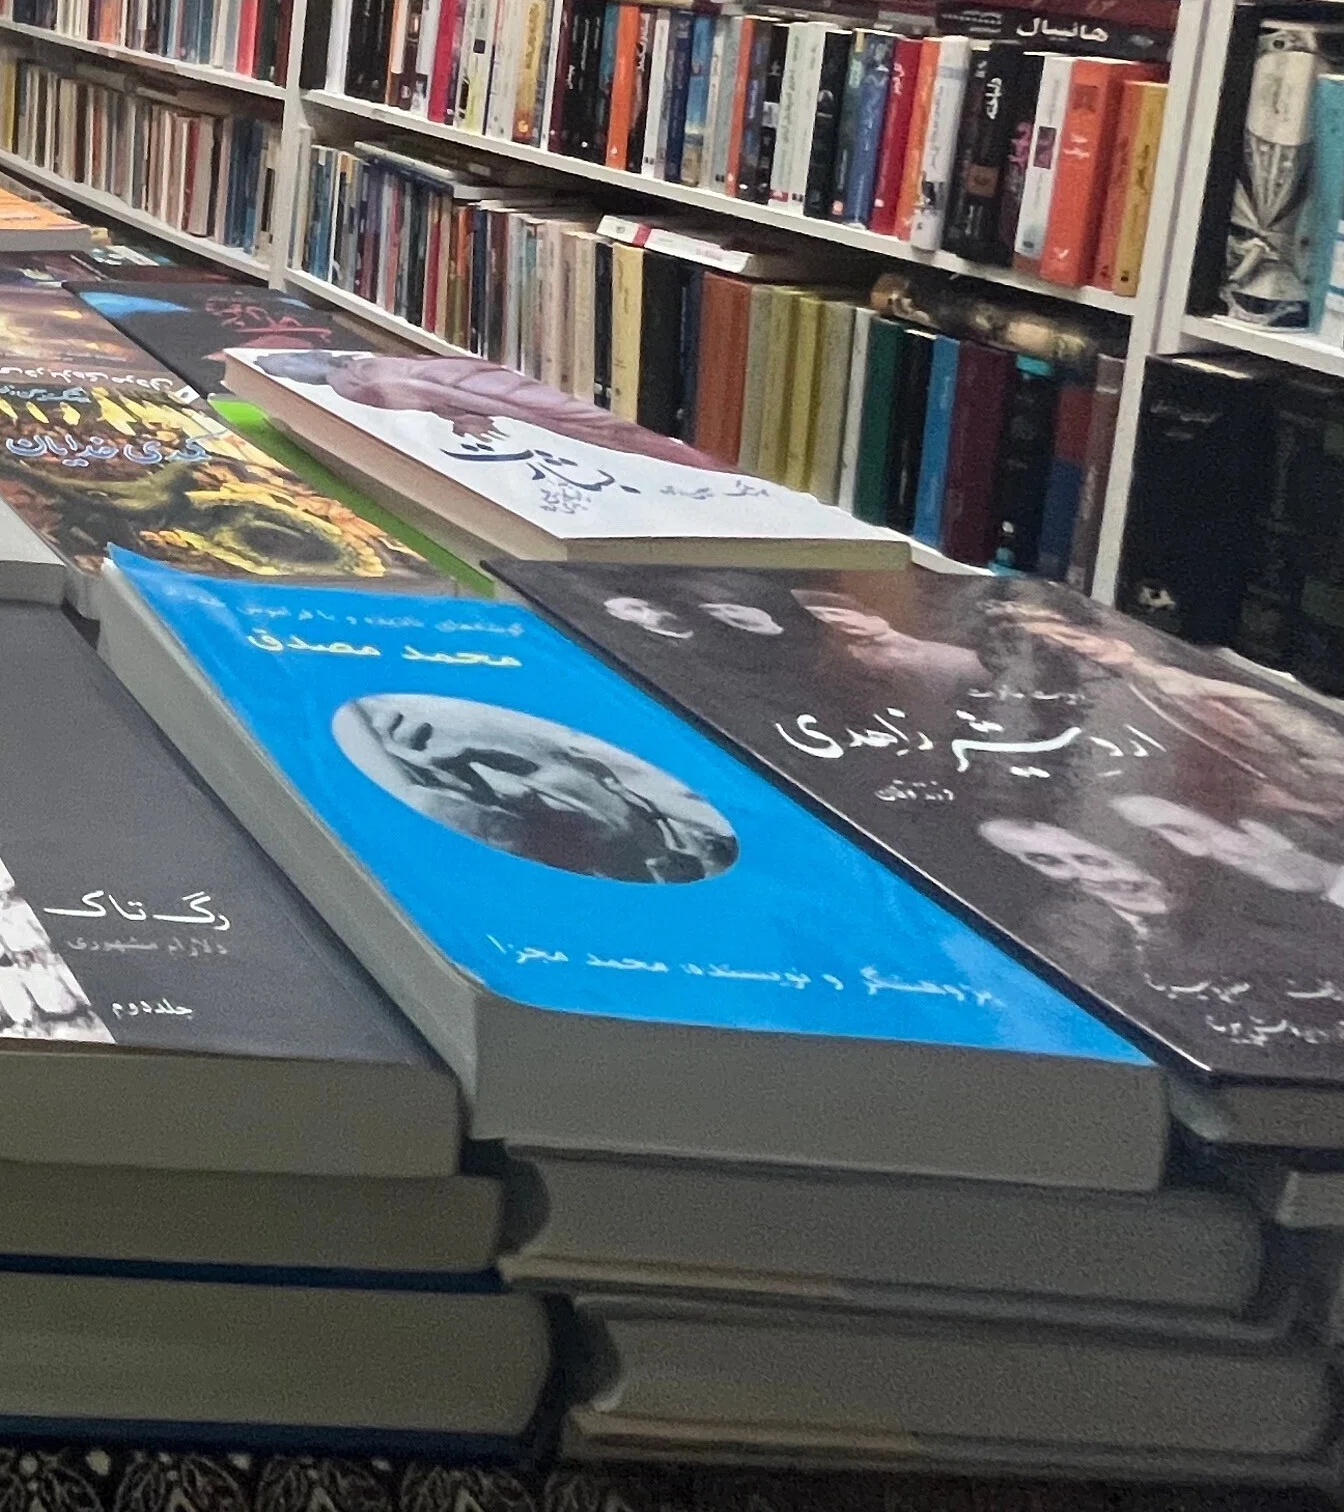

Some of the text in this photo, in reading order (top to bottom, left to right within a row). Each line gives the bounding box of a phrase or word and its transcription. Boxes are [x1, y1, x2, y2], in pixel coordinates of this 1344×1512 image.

[247, 626, 523, 668] محمد مصدق
[43, 890, 231, 931] رگ تاک
[586, 952, 669, 973] محمد
